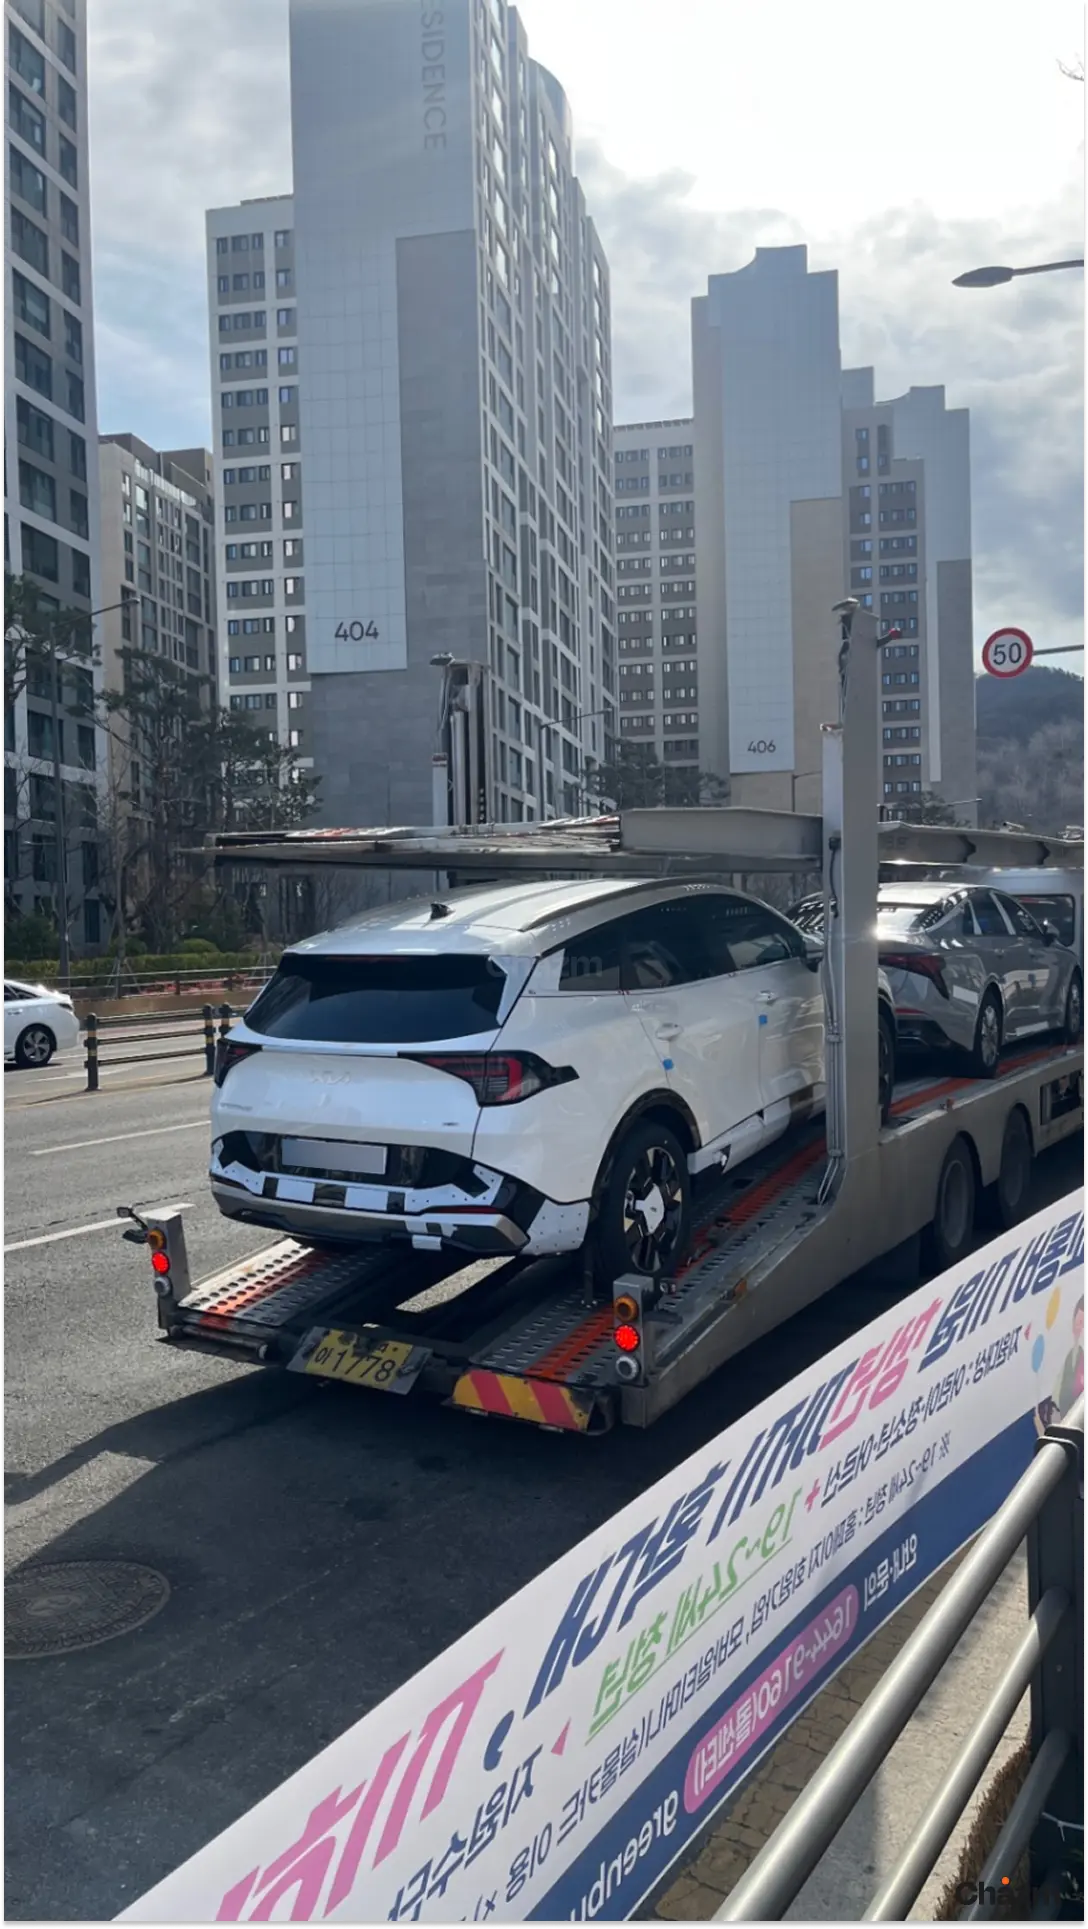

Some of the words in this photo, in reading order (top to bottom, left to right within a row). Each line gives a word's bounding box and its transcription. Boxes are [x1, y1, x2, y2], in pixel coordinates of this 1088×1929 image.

[334, 619, 379, 642] 404
[993, 642, 1022, 666] 50
[747, 739, 777, 754] 406
